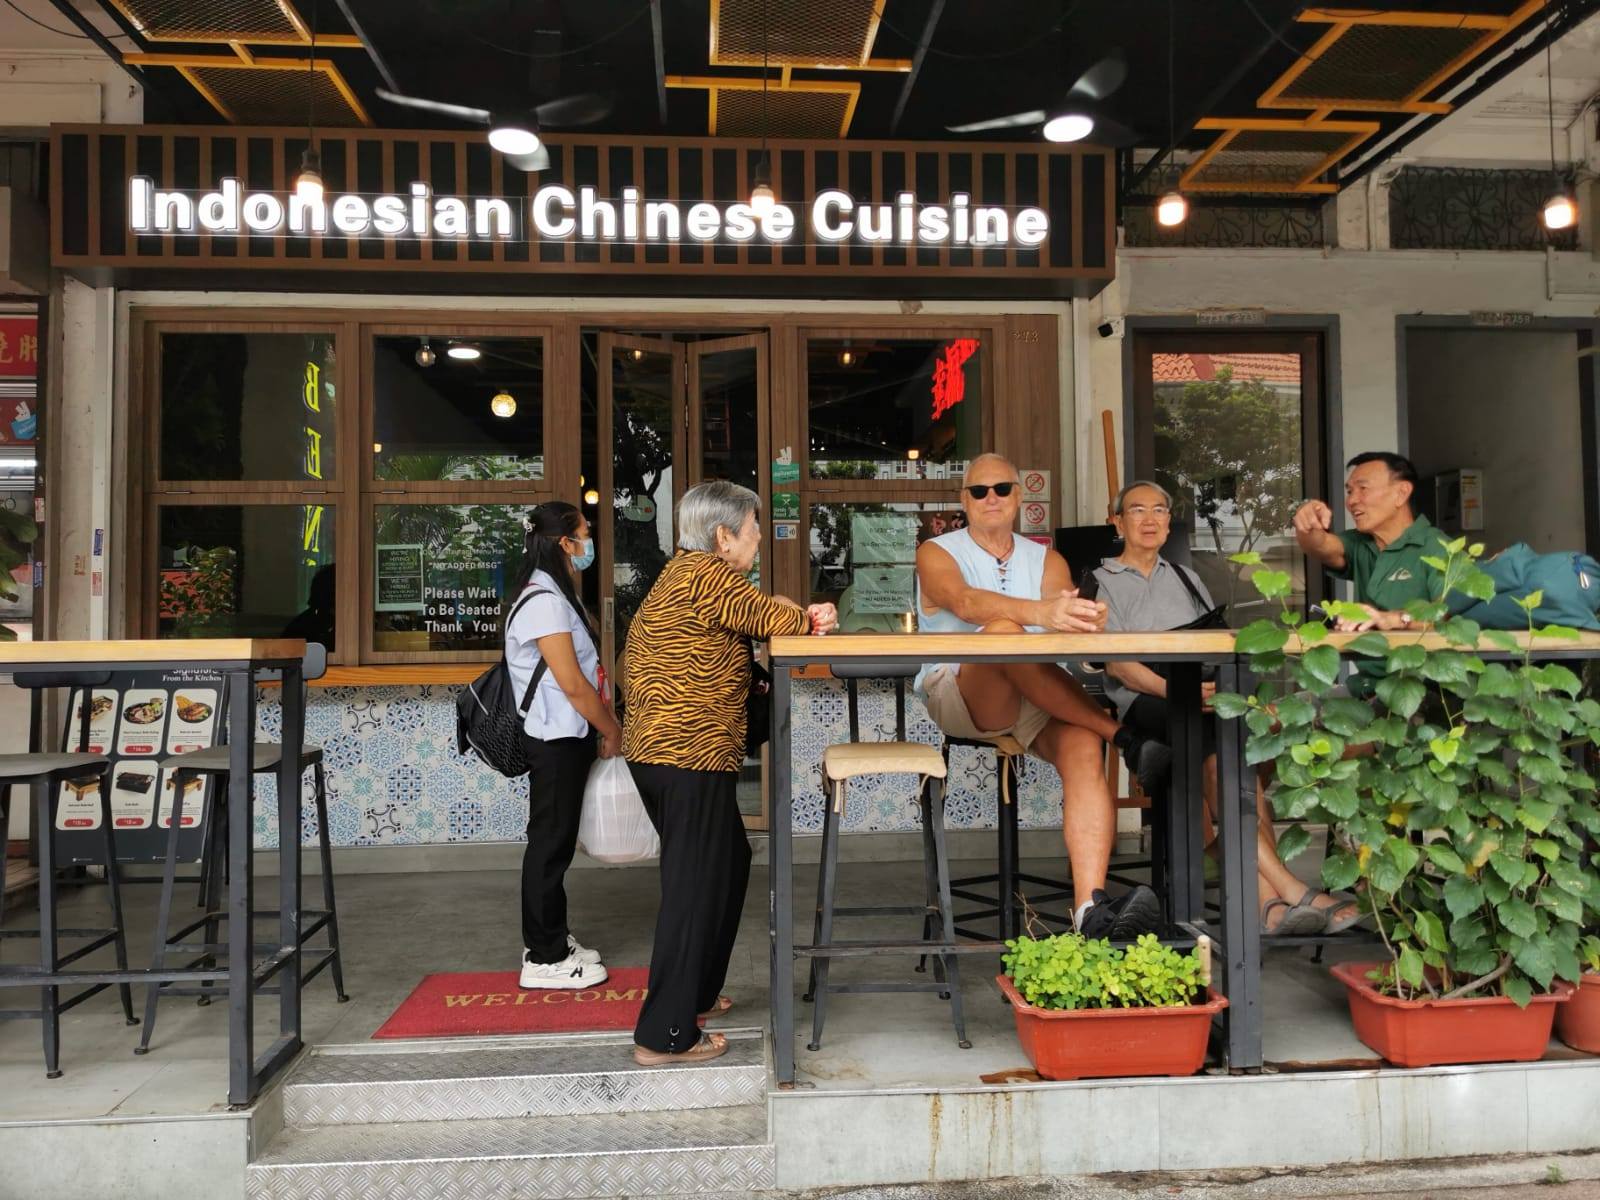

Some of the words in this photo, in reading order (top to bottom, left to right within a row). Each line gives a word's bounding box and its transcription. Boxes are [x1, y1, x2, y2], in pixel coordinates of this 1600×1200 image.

[130, 176, 512, 238] Indonesian
[532, 186, 795, 242] Chinese
[811, 190, 1050, 244] Cuisine
[424, 587, 464, 599] Please
[467, 587, 496, 599] Wait
[422, 604, 436, 616] To
[440, 604, 455, 616] Be
[457, 603, 501, 616] Seated
[424, 620, 463, 632] Thank
[472, 620, 496, 632] You
[162, 674, 181, 682] From
[182, 674, 193, 682] the
[195, 674, 222, 682] Kitchen
[444, 988, 649, 1008] WELCOM
